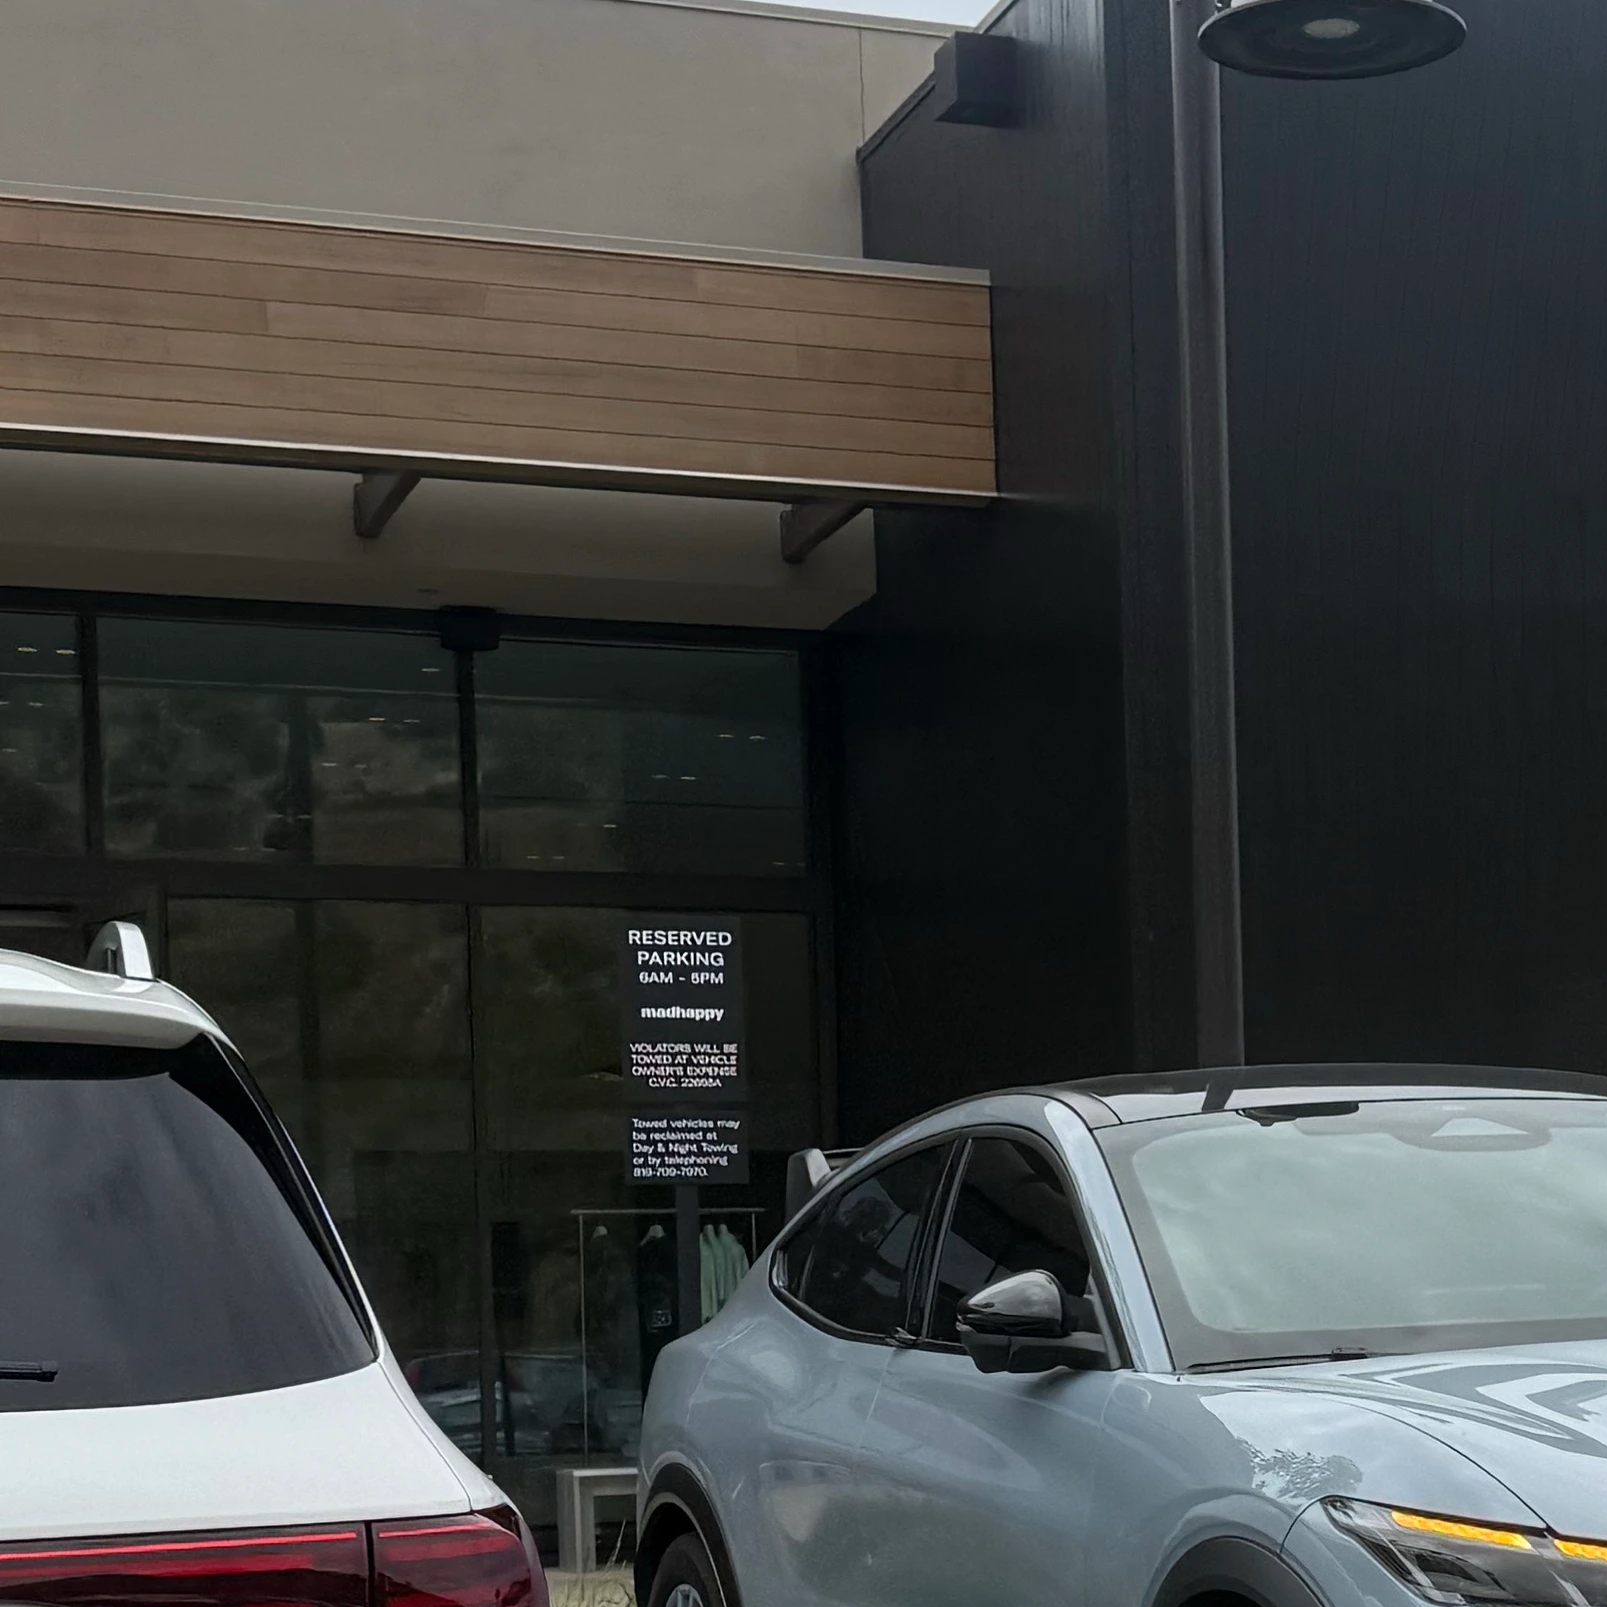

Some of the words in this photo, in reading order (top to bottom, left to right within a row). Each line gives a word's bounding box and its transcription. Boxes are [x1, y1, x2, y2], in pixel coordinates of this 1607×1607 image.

[628, 929, 732, 946] RESERVED
[637, 950, 725, 967] PARKING
[639, 971, 674, 984] 6AM
[640, 1005, 725, 1022] madhappy
[629, 1042, 691, 1054] VIOLATORS
[693, 1043, 721, 1054] WILL
[722, 1043, 738, 1054] BE
[630, 1054, 673, 1065] TOWED
[674, 1054, 689, 1064] AT
[691, 1054, 738, 1065] VEHICLE
[686, 1066, 738, 1077] EXPENSE
[631, 1118, 668, 1130] Towed
[669, 1118, 715, 1130] vehicles
[717, 1119, 741, 1131] may
[632, 1131, 648, 1141] be
[650, 1130, 704, 1141] reclaimed
[705, 1131, 719, 1141] at
[632, 1142, 655, 1154] Day
[657, 1142, 667, 1153] &
[668, 1142, 699, 1155] Night
[701, 1142, 739, 1155] Towing
[632, 1156, 647, 1165] or
[648, 1154, 662, 1166] by
[664, 1154, 729, 1166] telephoning
